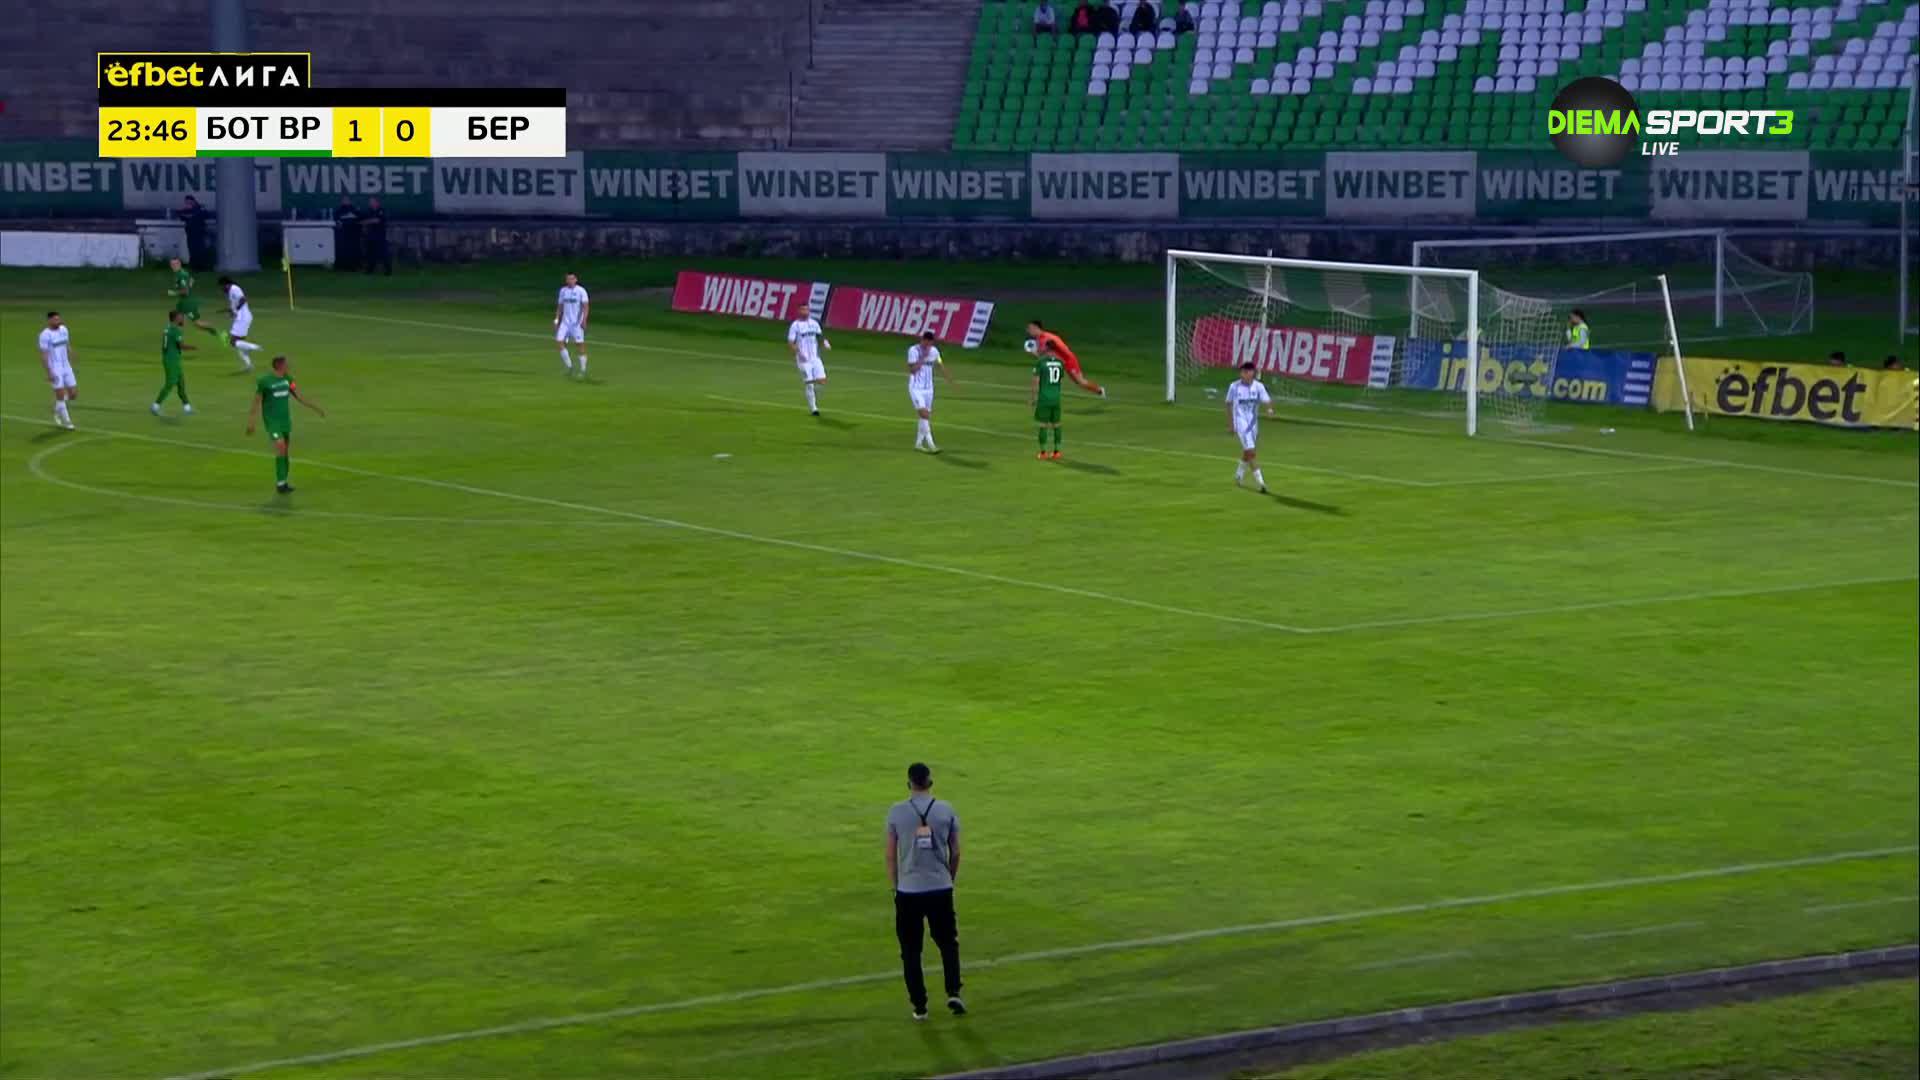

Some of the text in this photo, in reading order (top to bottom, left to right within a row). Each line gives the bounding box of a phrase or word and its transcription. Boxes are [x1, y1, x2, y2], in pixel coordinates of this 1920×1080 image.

[0, 163, 116, 192] INBET
[288, 163, 427, 194] WINBET
[442, 166, 577, 197] WINBET
[590, 168, 733, 199] WINBET
[745, 170, 878, 199] WINBET
[892, 171, 1025, 200] WINBET
[1039, 170, 1171, 200] WINBET
[1186, 170, 1319, 200] WINBET
[1334, 169, 1469, 200] WINBET
[1483, 169, 1621, 201] WINBET
[1660, 170, 1802, 200] WINBET
[701, 277, 797, 320] WINBET
[857, 294, 960, 339] WINBET
[1232, 325, 1356, 379] WINBET
[1048, 366, 1061, 384] 10
